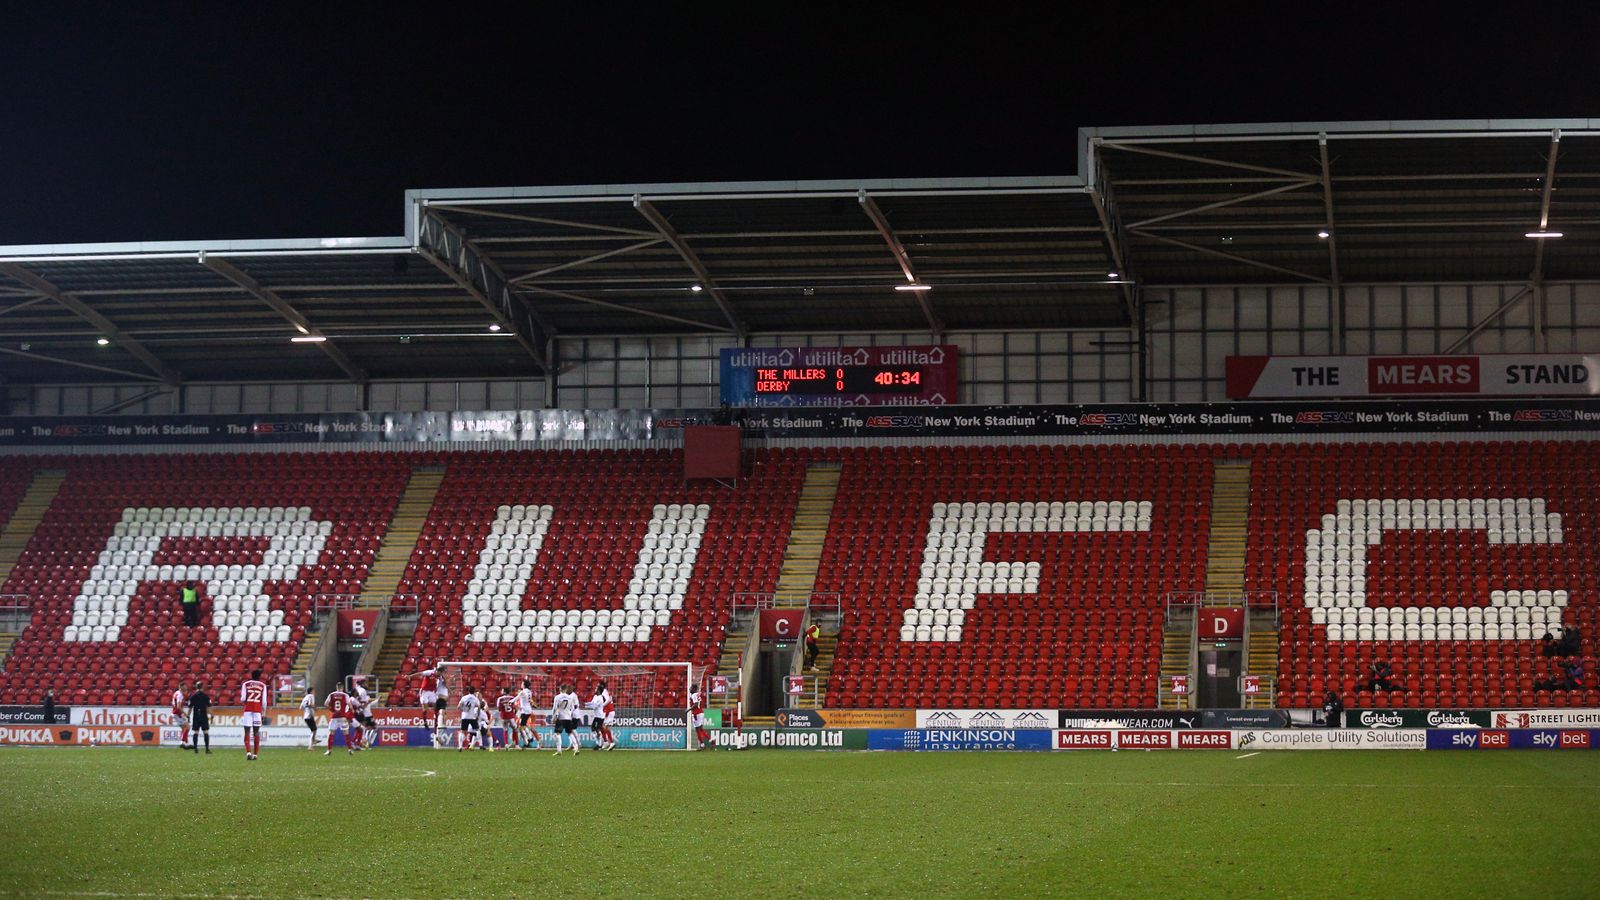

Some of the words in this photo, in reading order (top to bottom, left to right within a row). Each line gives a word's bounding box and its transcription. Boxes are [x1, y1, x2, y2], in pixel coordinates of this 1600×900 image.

[731, 352, 778, 367] utilita
[805, 352, 852, 366] utilita
[881, 350, 928, 365] utilita
[757, 369, 777, 380] THE
[783, 369, 826, 380] MILLERS
[836, 369, 844, 379] 0
[874, 372, 920, 385] 40:34
[1292, 367, 1339, 386] THE
[1377, 365, 1472, 385] MEARS
[1506, 365, 1589, 384] STAND
[757, 381, 789, 392] DERBY
[836, 381, 844, 391] 0
[842, 417, 863, 427] The
[925, 416, 950, 426] New
[954, 416, 981, 426] York
[984, 415, 1035, 426] Stadium
[1055, 415, 1077, 425] The
[1140, 414, 1166, 424] New
[1169, 414, 1196, 424] York
[1200, 413, 1251, 424] Stadium
[1271, 413, 1293, 423] The
[1356, 412, 1383, 422] New
[1386, 412, 1413, 422] York
[1417, 411, 1469, 422] Stadium
[1489, 411, 1511, 421] The
[1574, 410, 1600, 420] New
[227, 424, 247, 434] The
[305, 423, 329, 433] New
[333, 423, 357, 432] York
[361, 422, 408, 432] Stadum
[773, 417, 823, 428] Stadium
[32, 426, 52, 436] The
[107, 426, 131, 435] New
[135, 425, 158, 435] York
[162, 424, 209, 434] Stadium
[64, 506, 333, 643] R
[463, 503, 709, 642] U
[900, 500, 1152, 642] F
[1304, 497, 1568, 641] C
[352, 619, 365, 635] B
[775, 618, 789, 635] C
[1215, 617, 1228, 634] D
[246, 689, 262, 702] 22
[334, 700, 341, 711] 8
[14, 712, 23, 720] of
[24, 712, 67, 721] Comrce
[387, 716, 412, 726] Motor
[612, 717, 652, 726] PURPOSE
[654, 717, 687, 726] MEDIA.
[788, 713, 809, 722] Places
[1361, 711, 1403, 725] Carlsberg
[1427, 711, 1470, 725] Carlsberg
[1530, 715, 1563, 724] STREET
[1568, 714, 1600, 723] LIGHTI
[788, 720, 811, 728] Leisure
[926, 720, 962, 728] CENTURY
[969, 720, 1005, 728] CENTURY
[1013, 720, 1049, 728] CENTURY
[0, 727, 54, 743] PUKKA
[77, 728, 137, 744] PUKKA
[382, 731, 404, 742] bet
[631, 730, 681, 743] embark
[711, 730, 748, 748] Hodge
[760, 730, 818, 746] Clemco
[821, 730, 843, 746] Ltd
[924, 730, 1015, 742] JENKINSON
[1062, 734, 1108, 745] MEARS
[1122, 734, 1168, 745] MEARS
[1182, 734, 1228, 745] MEARS
[1262, 731, 1323, 746] Complete
[1328, 731, 1363, 747] Utility
[1367, 731, 1425, 745] Solutions
[1453, 732, 1477, 747] sky
[1481, 732, 1506, 744] bet
[1533, 732, 1557, 747] sky
[1562, 732, 1587, 744] bet
